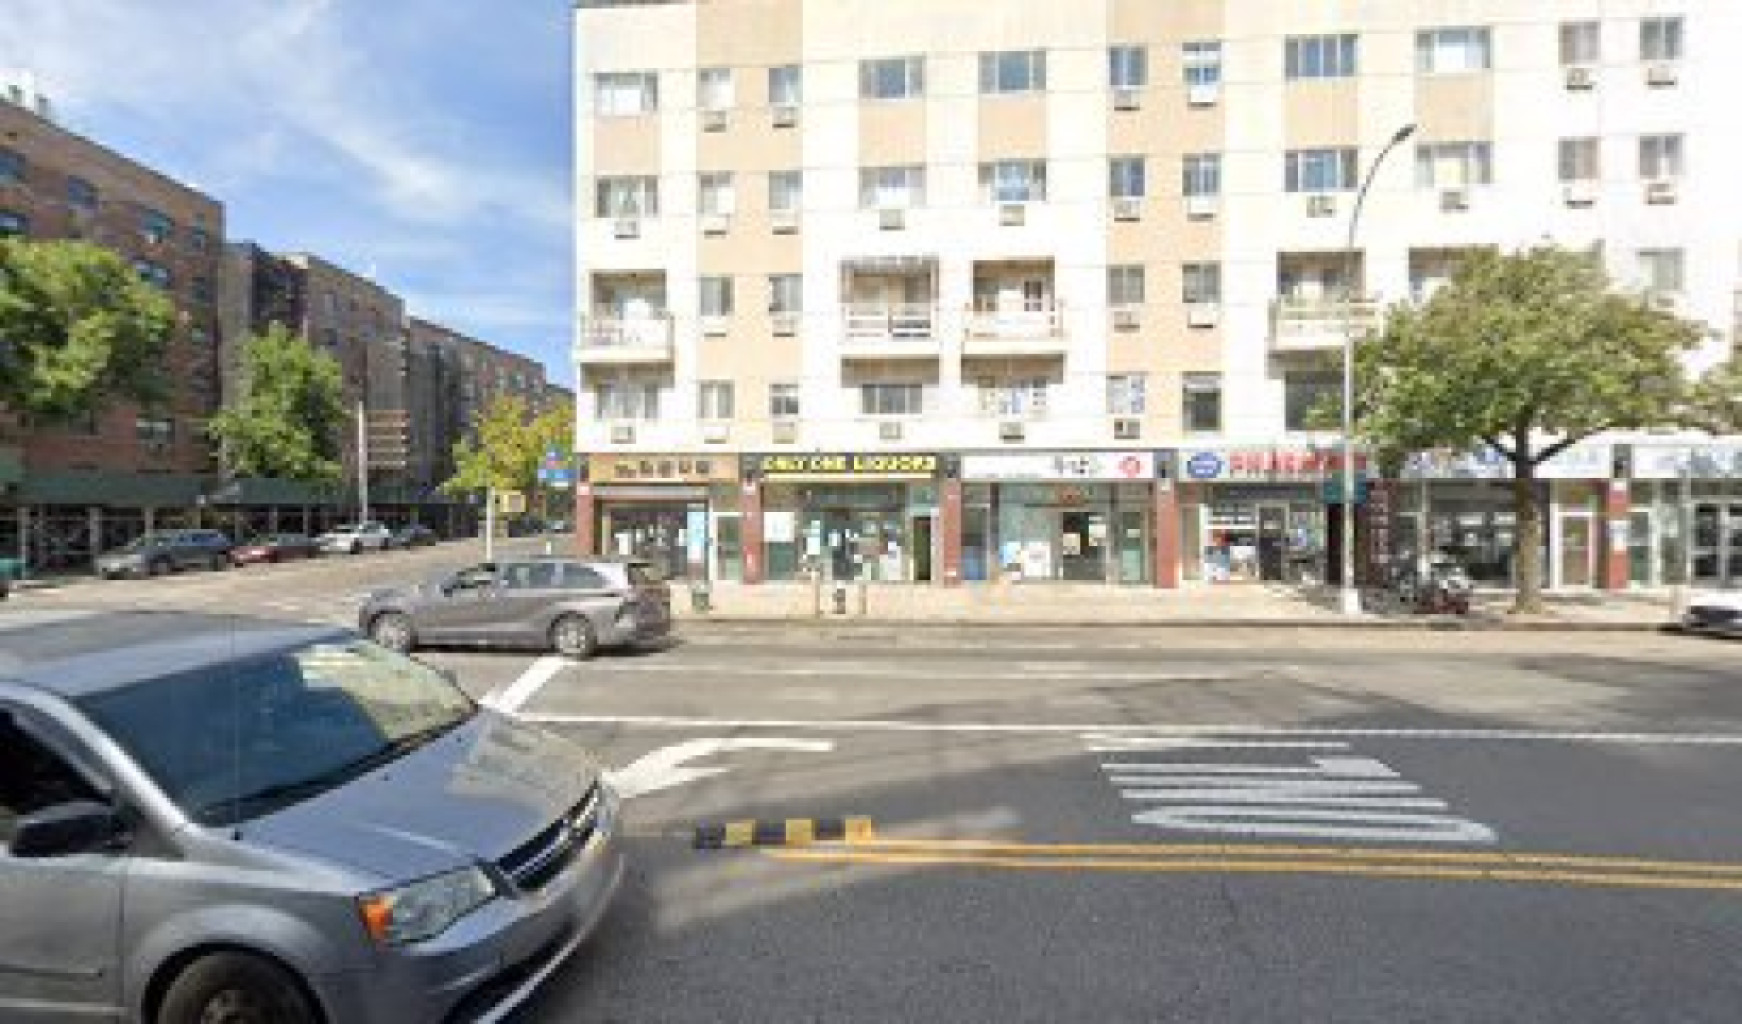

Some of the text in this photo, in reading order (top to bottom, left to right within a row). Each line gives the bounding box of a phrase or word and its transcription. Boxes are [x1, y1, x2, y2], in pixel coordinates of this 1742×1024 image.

[762, 455, 937, 470] ONLY ONE LIQUORS
[1229, 451, 1368, 471] PHARMA
